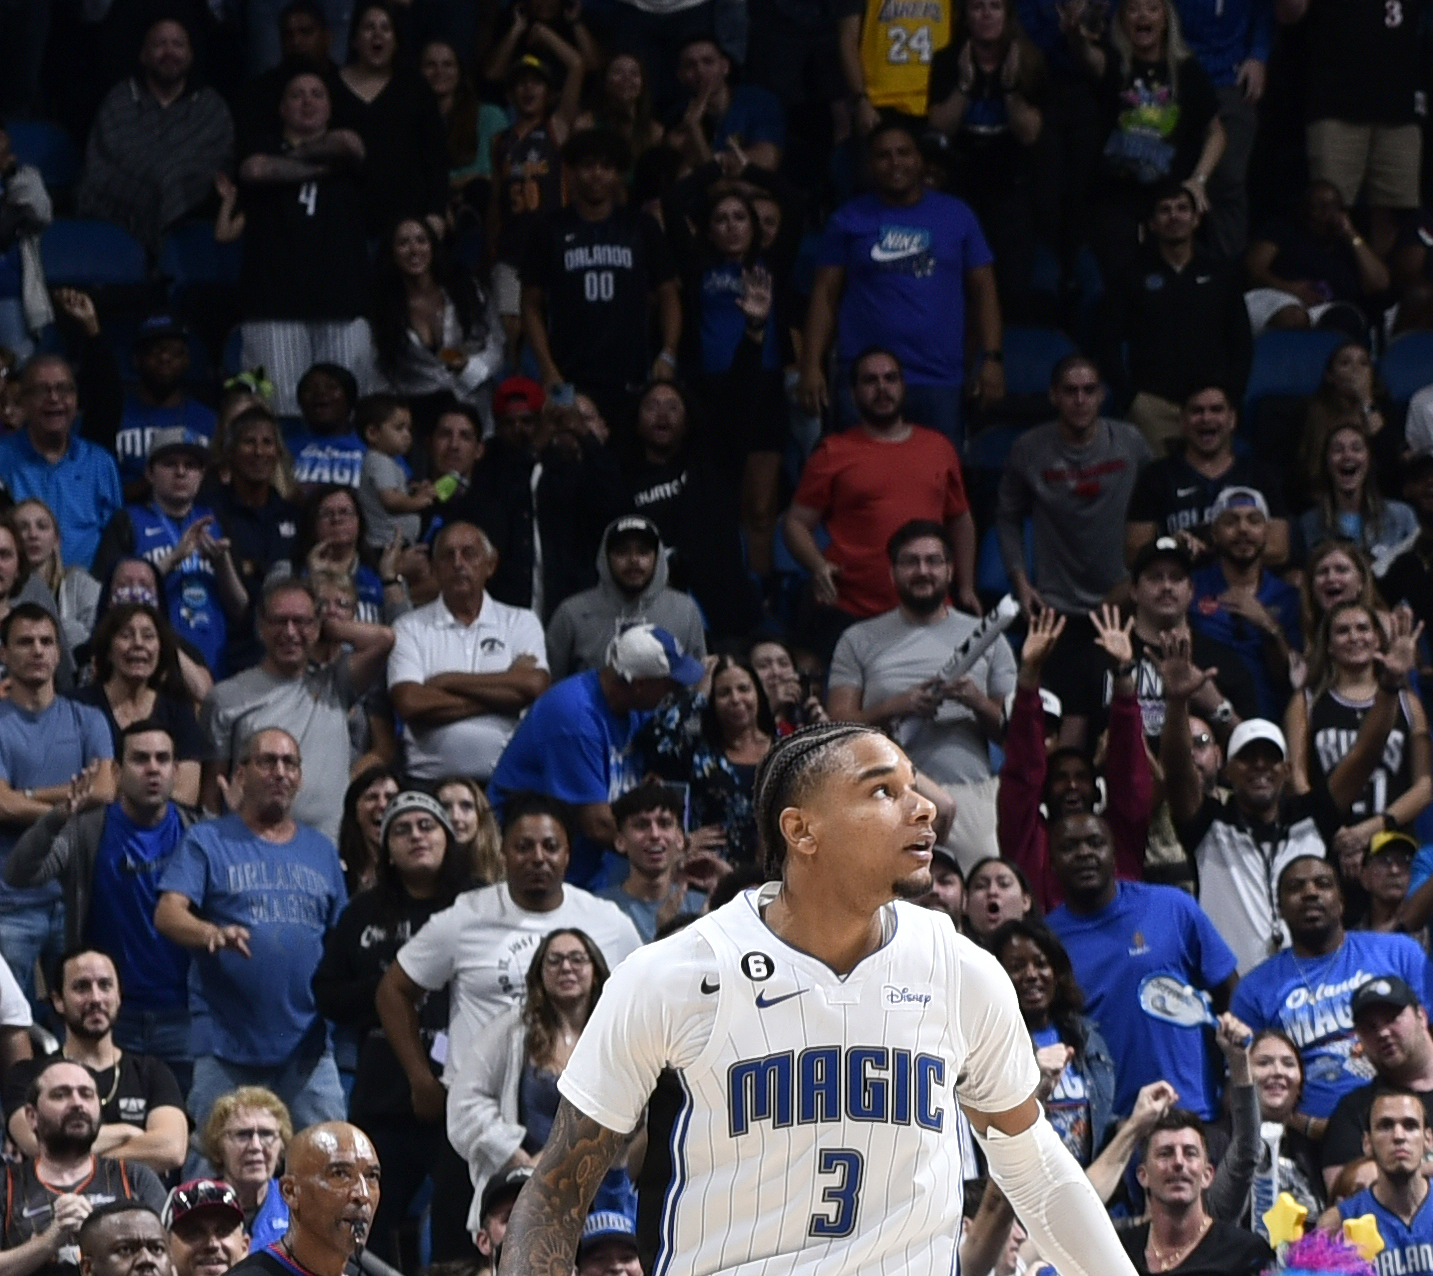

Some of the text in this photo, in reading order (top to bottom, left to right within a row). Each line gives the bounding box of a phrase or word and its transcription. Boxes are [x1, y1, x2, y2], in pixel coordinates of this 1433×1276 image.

[887, 24, 932, 65] 24
[299, 180, 318, 216] 4
[564, 243, 633, 271] ORLANDO
[584, 269, 615, 302] 00
[1279, 1004, 1357, 1048] MAG
[726, 1046, 945, 1137] MAGIC
[807, 1148, 864, 1240] 3
